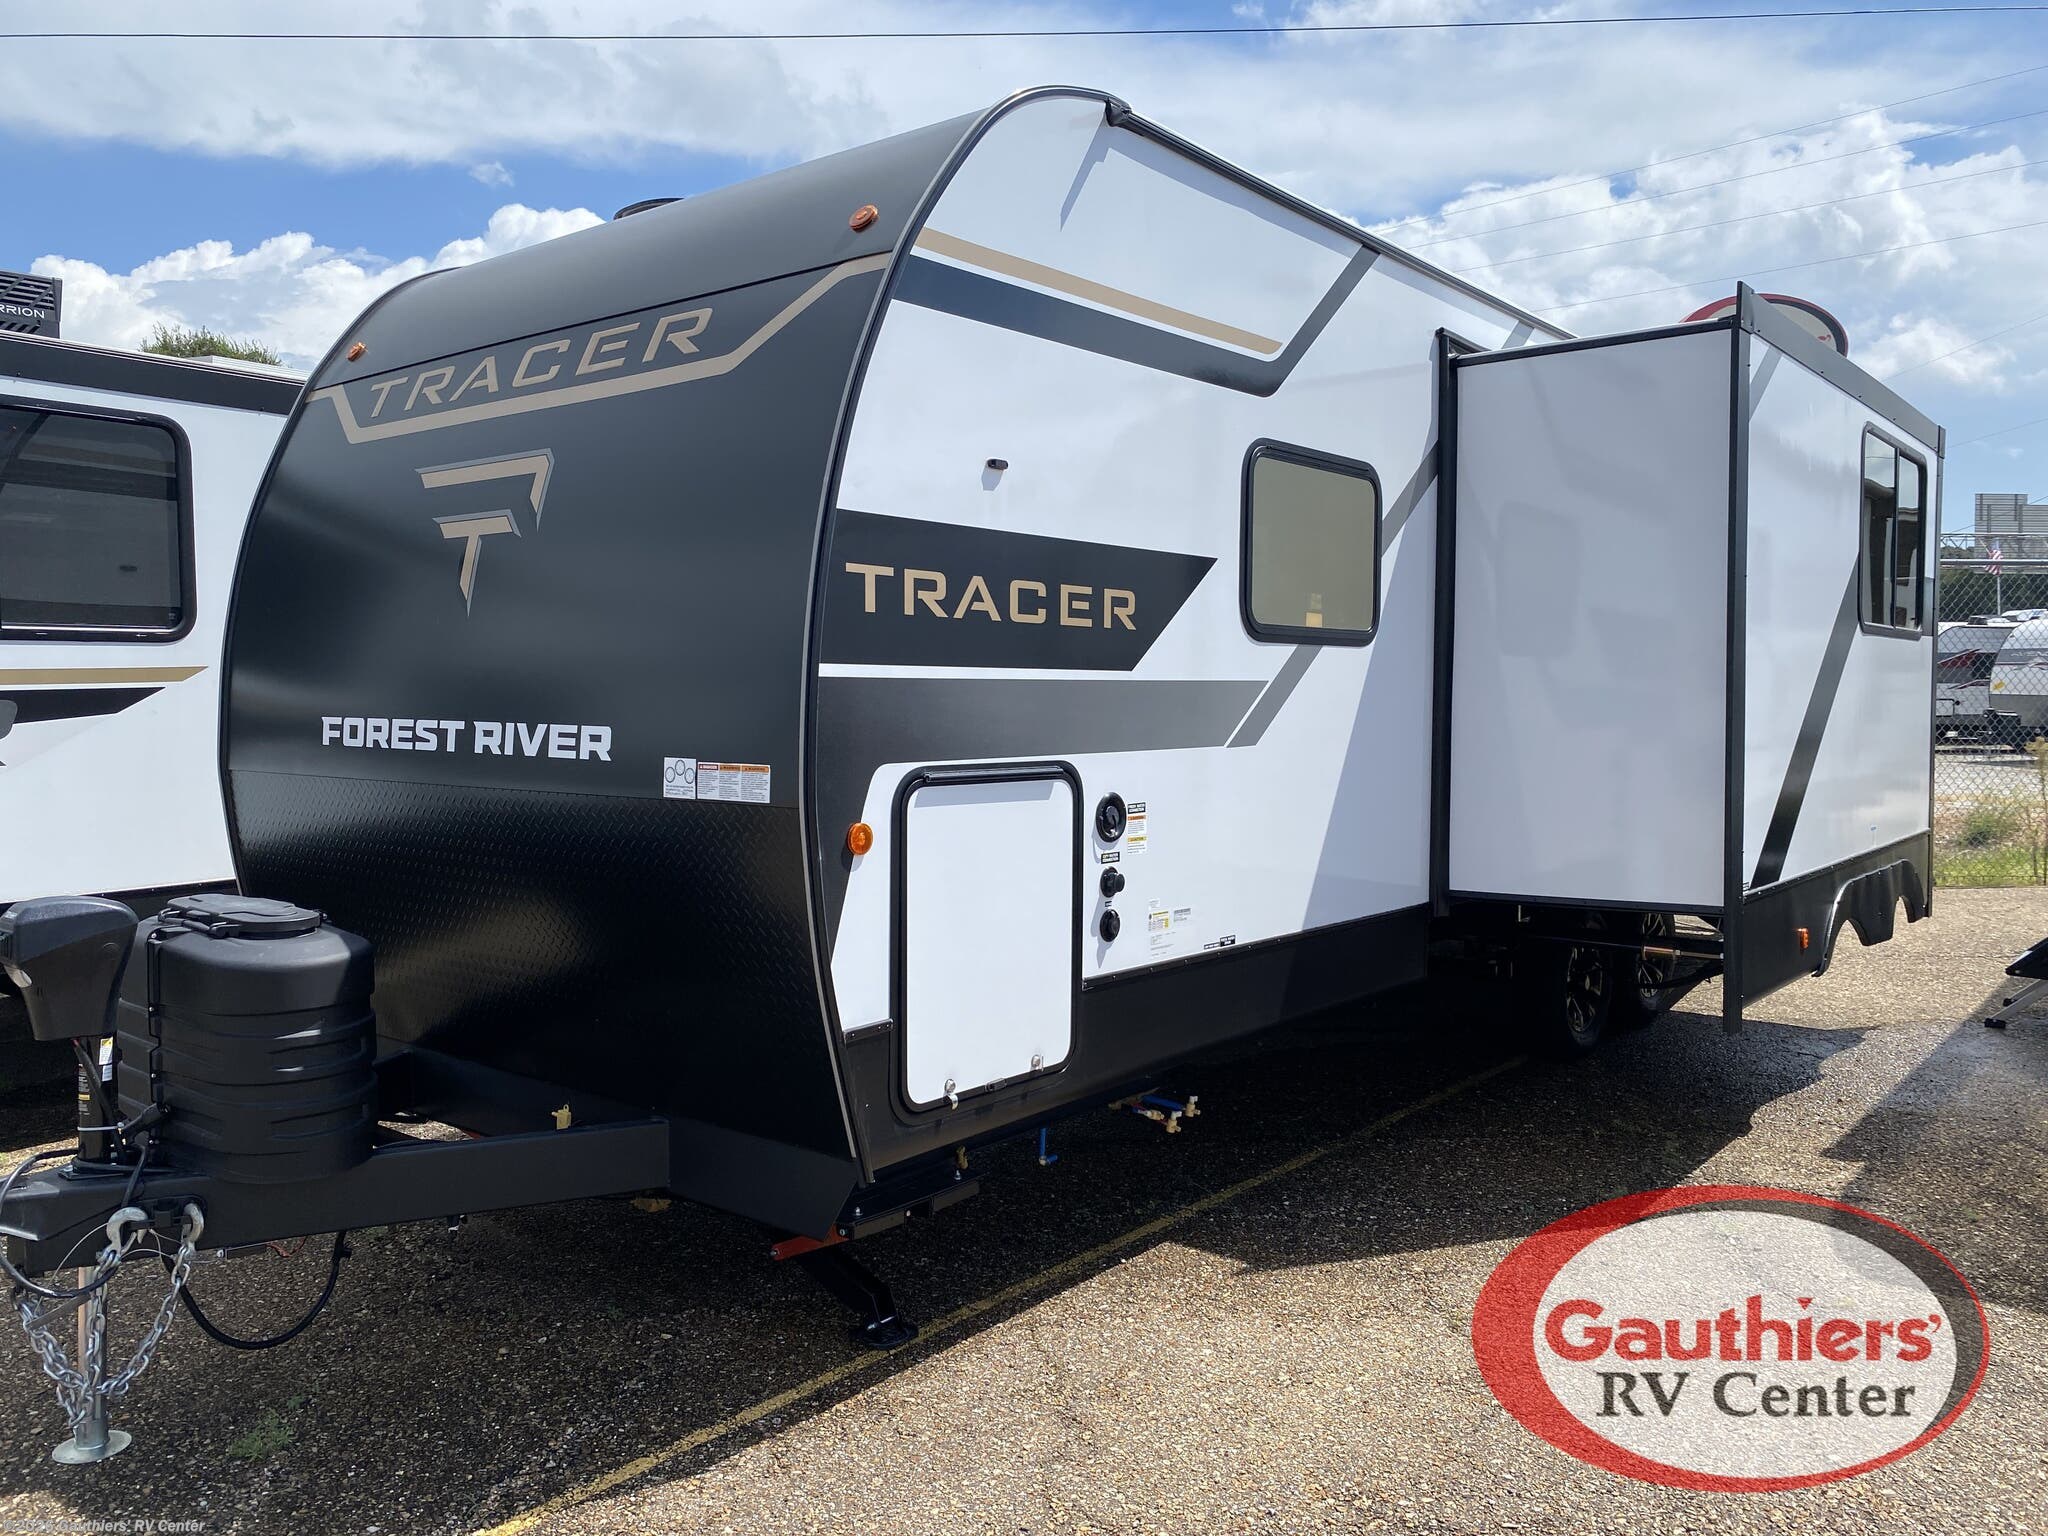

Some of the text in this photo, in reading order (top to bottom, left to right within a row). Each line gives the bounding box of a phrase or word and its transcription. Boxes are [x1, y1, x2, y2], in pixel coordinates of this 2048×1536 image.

[370, 307, 713, 418] TRACER
[845, 562, 1137, 631] TRACER
[321, 716, 612, 761] FOREST RIVER
